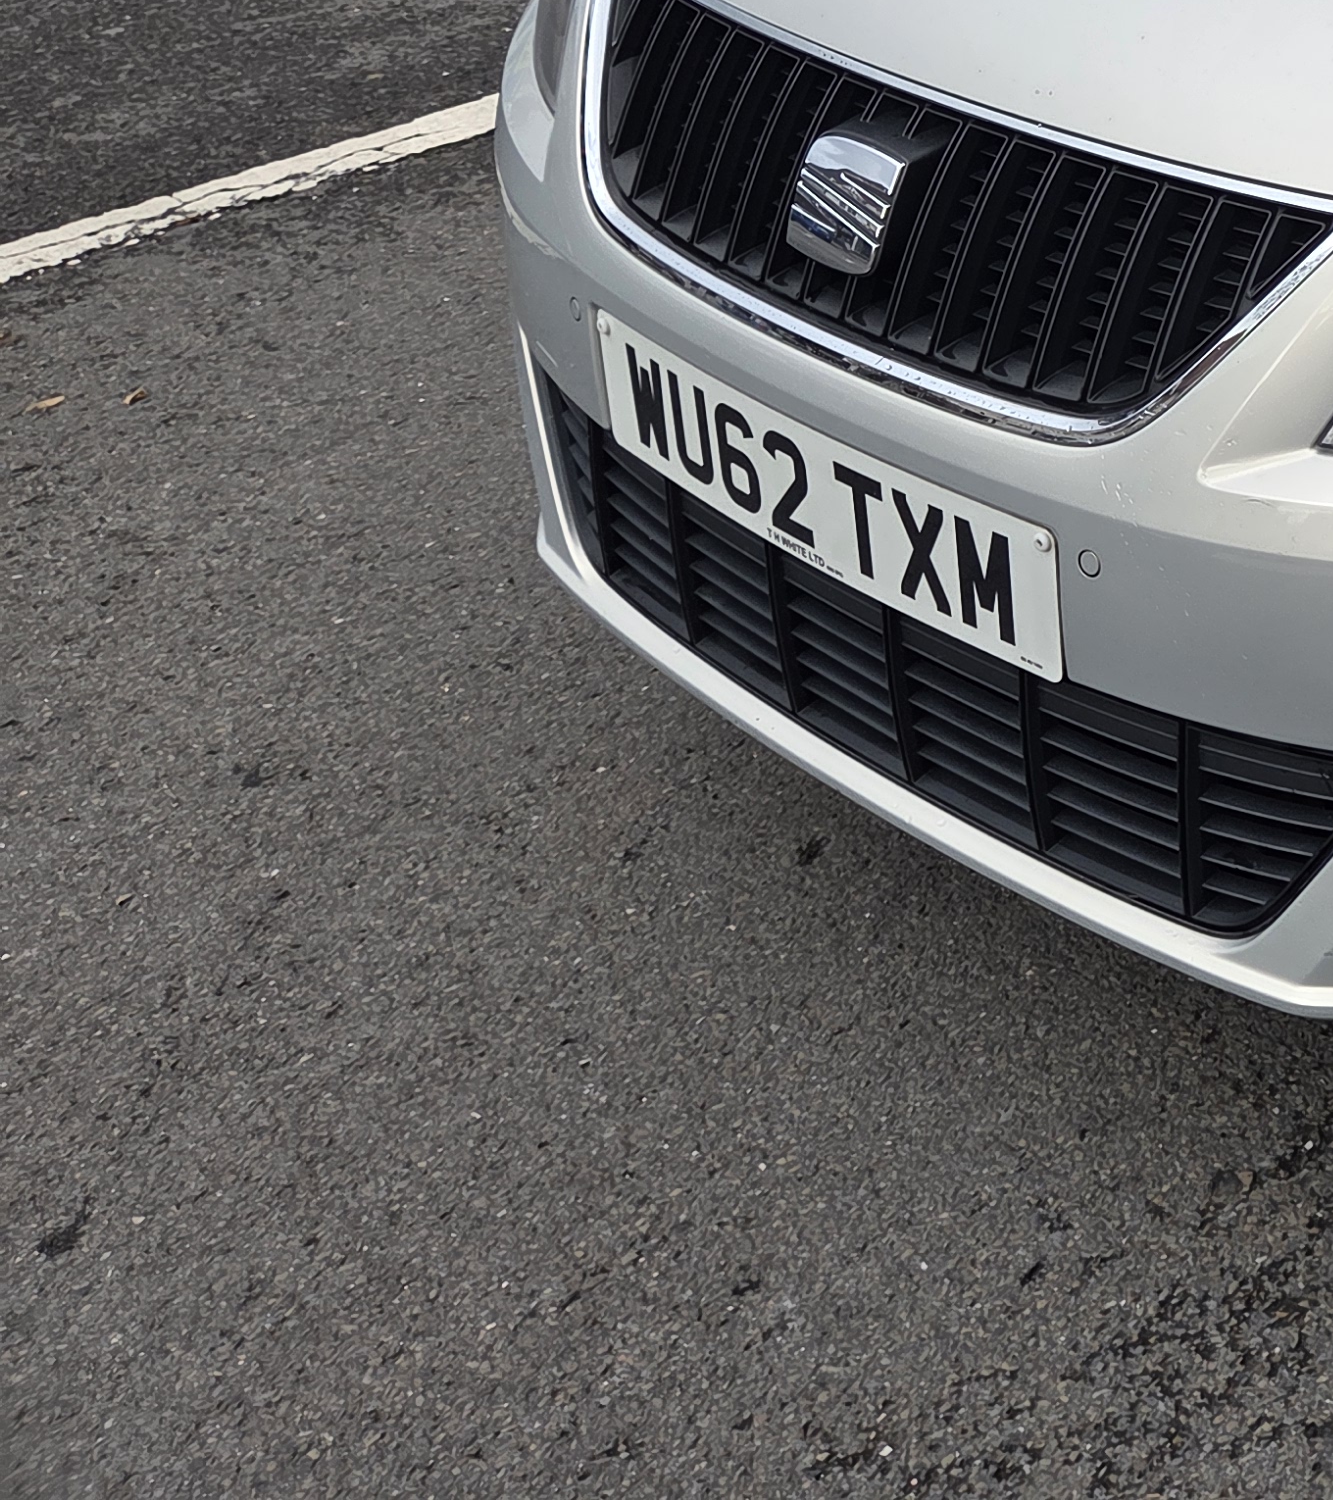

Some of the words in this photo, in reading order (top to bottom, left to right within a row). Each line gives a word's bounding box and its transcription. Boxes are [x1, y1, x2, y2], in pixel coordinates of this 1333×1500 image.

[624, 342, 815, 549] WU62
[832, 460, 1017, 647] TXM
[766, 527, 772, 538] T
[781, 536, 808, 559] WHITE
[808, 550, 826, 568] LTD
